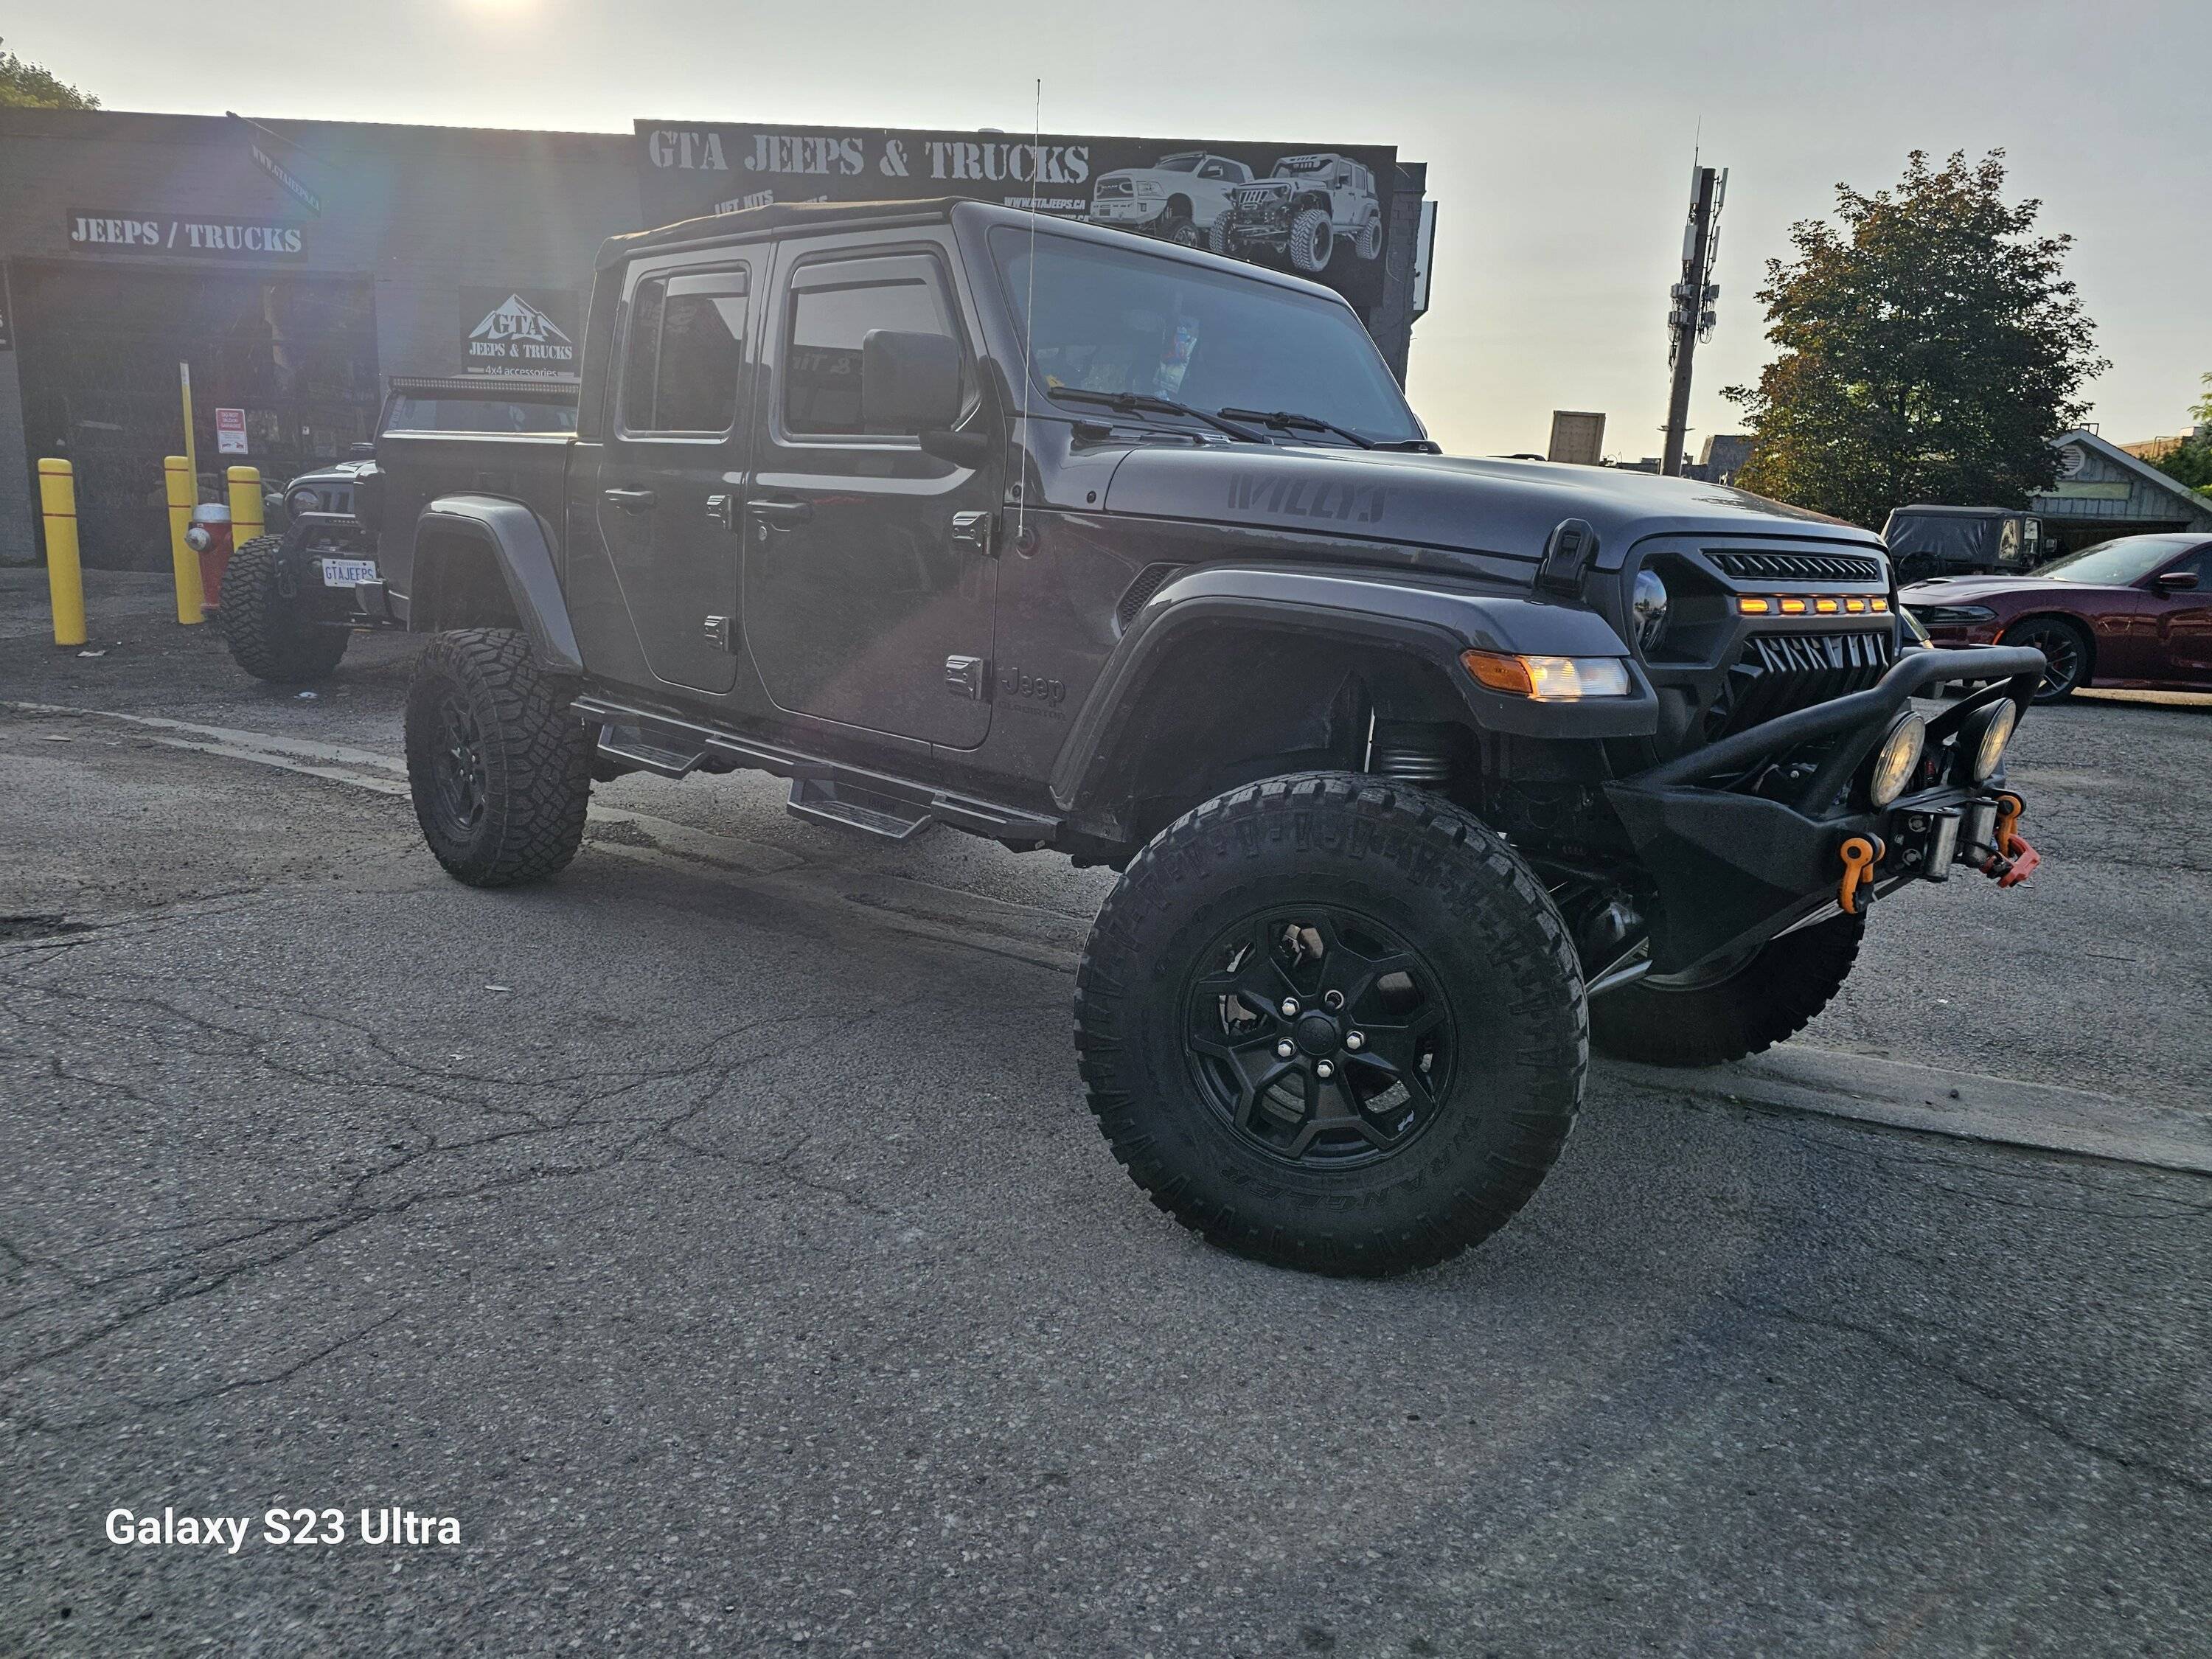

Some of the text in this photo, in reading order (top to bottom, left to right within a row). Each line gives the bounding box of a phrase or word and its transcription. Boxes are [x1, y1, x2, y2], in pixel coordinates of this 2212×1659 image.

[649, 130, 1089, 184] GTA JEEPS & TRUCKS
[743, 189, 773, 209] KITS
[1004, 196, 1085, 210] WWW.GTAJEEPS.CA
[72, 218, 302, 253] JEEPS / TRUCKS
[493, 314, 542, 335] GTA
[469, 341, 573, 360] JEEPS & TRUCKS
[485, 366, 558, 378] 4x4 accessories
[1228, 473, 1395, 524] WILLYS
[325, 566, 374, 581] GTAJEEPS
[998, 667, 1065, 708] Jeep
